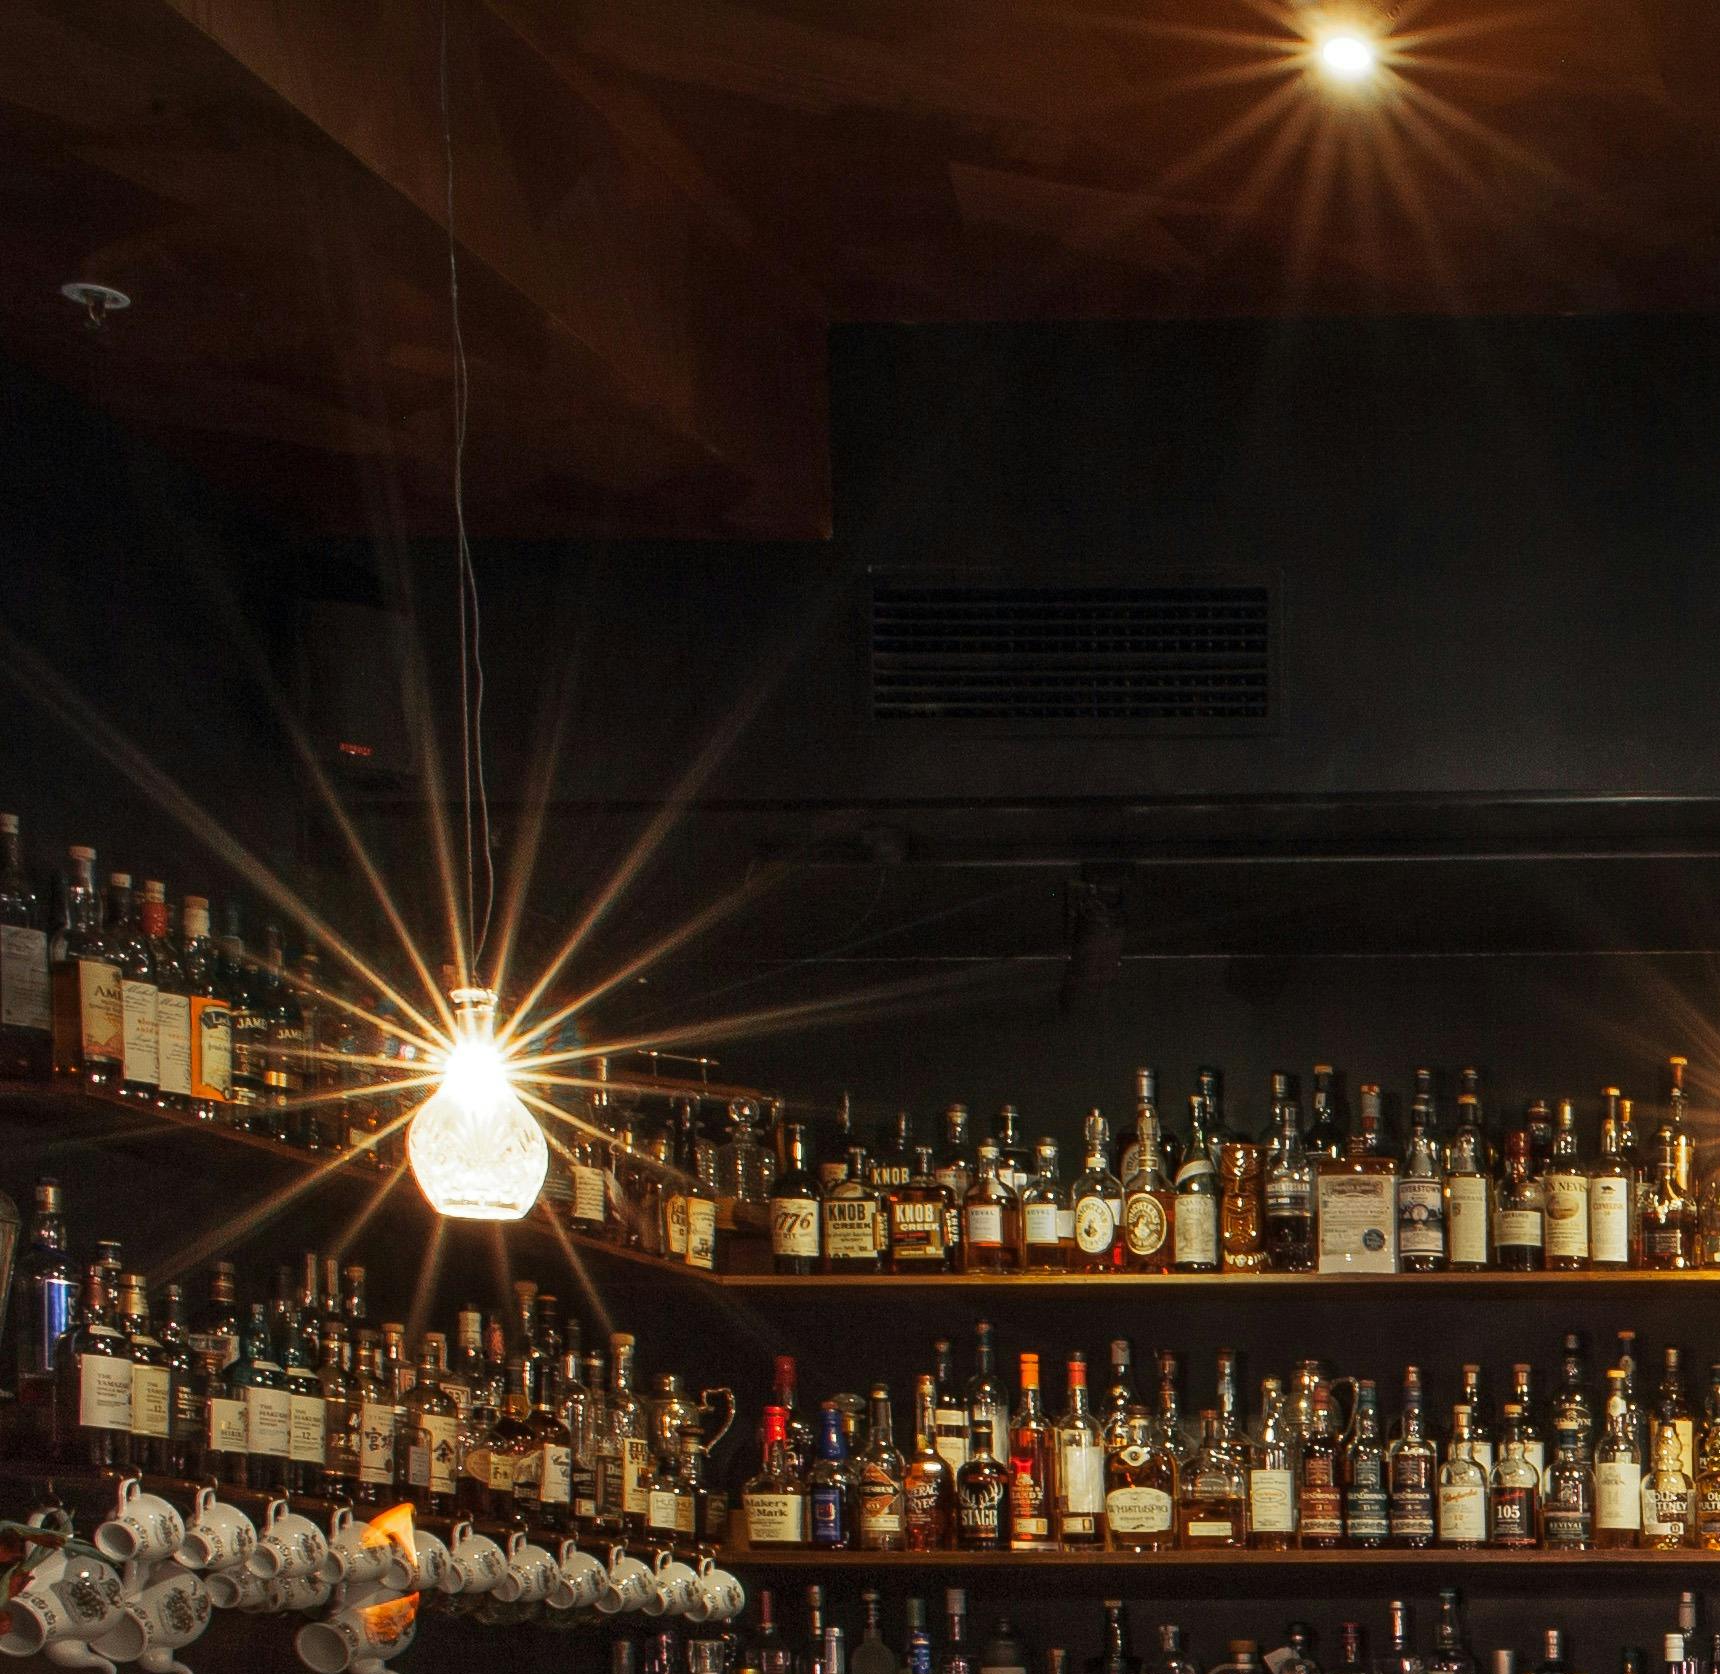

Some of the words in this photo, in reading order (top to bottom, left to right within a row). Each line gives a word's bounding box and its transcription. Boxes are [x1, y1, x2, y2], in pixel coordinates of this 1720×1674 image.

[828, 1203, 866, 1222] KNOB
[895, 1203, 934, 1222] KNOB
[832, 1222, 871, 1230] CREEK
[757, 1509, 787, 1519] Mark
[961, 1507, 998, 1526] STAGG
[1496, 1505, 1521, 1520] 105
